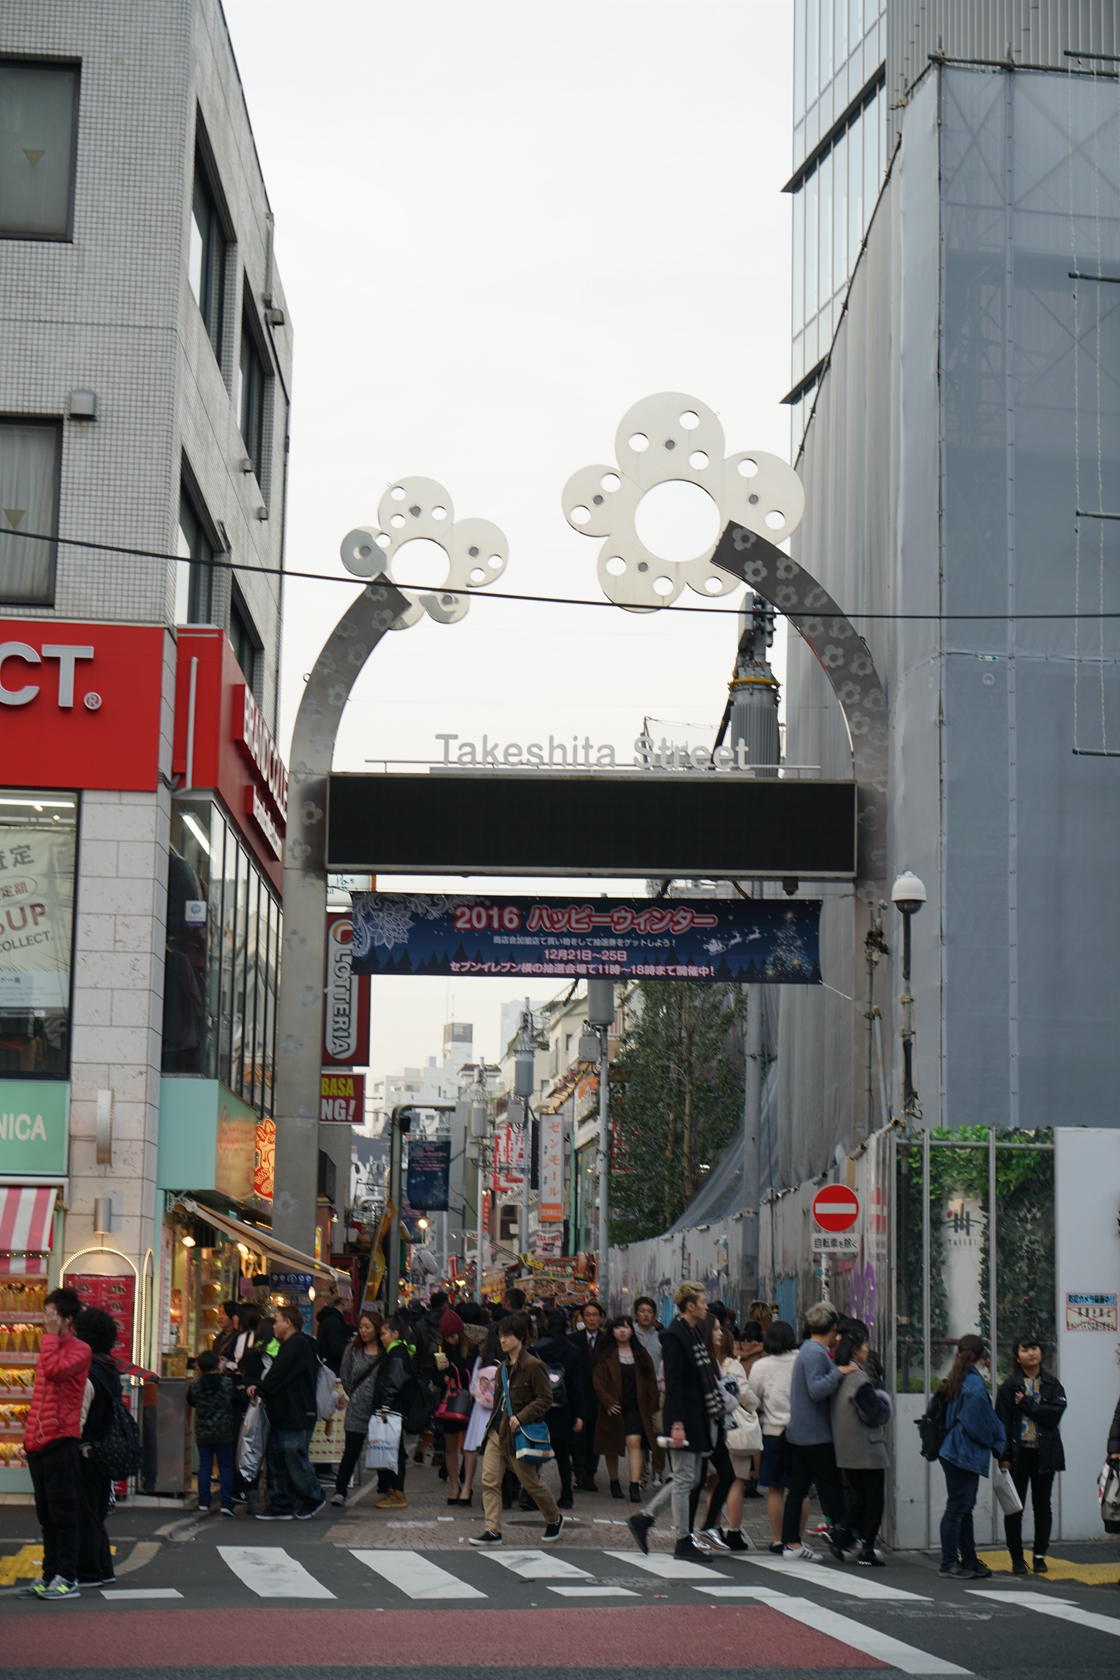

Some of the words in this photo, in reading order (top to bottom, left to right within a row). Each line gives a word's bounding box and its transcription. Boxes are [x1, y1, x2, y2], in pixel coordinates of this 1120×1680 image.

[435, 733, 616, 768] Takeshita
[633, 735, 750, 771] Street
[454, 904, 521, 931] 2016
[526, 904, 718, 935] ハッピーウィンター
[0, 930, 54, 953] OLLECT.
[332, 948, 352, 1056] LOTTERIA
[321, 1077, 355, 1097] BASA
[0, 1112, 47, 1142] NICA
[814, 1238, 858, 1249] 自転車を除く
